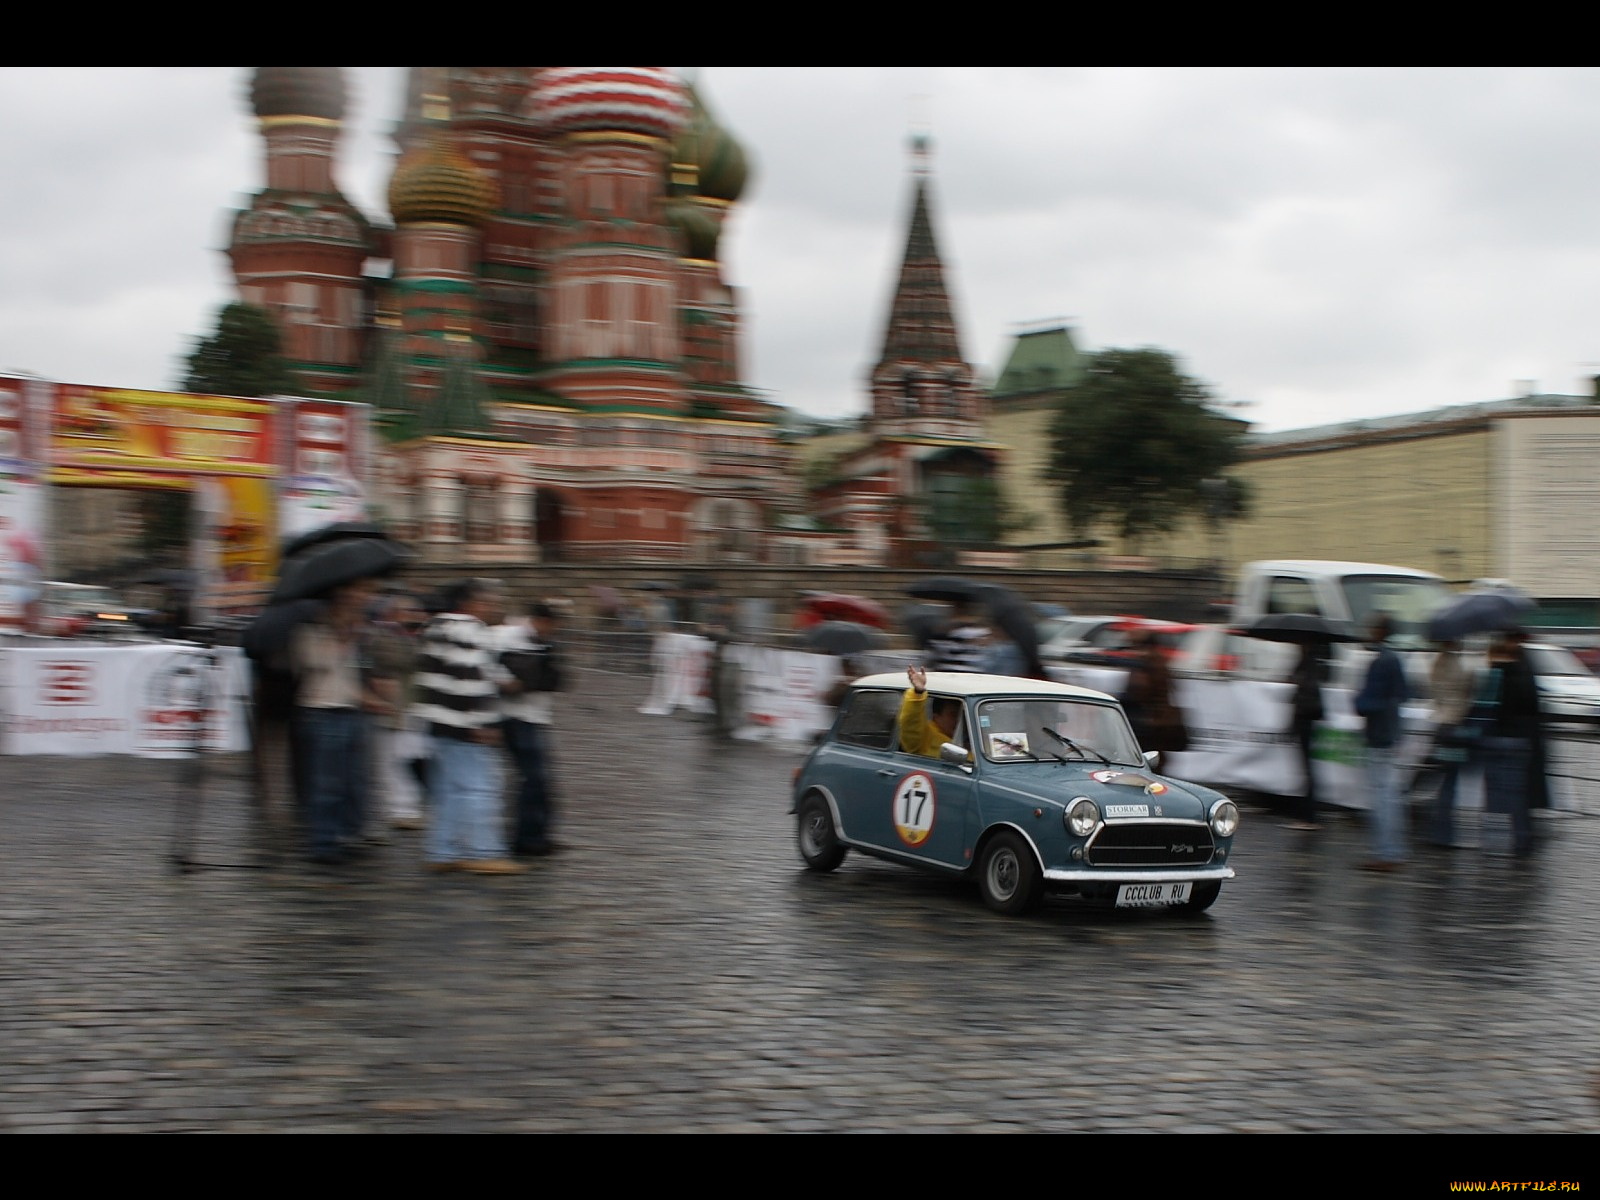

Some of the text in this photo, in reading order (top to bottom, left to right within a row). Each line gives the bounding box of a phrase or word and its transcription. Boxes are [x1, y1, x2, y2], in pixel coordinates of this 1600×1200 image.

[903, 789, 928, 826] 17
[1107, 805, 1148, 813] STORICAR
[1171, 884, 1185, 899] RU
